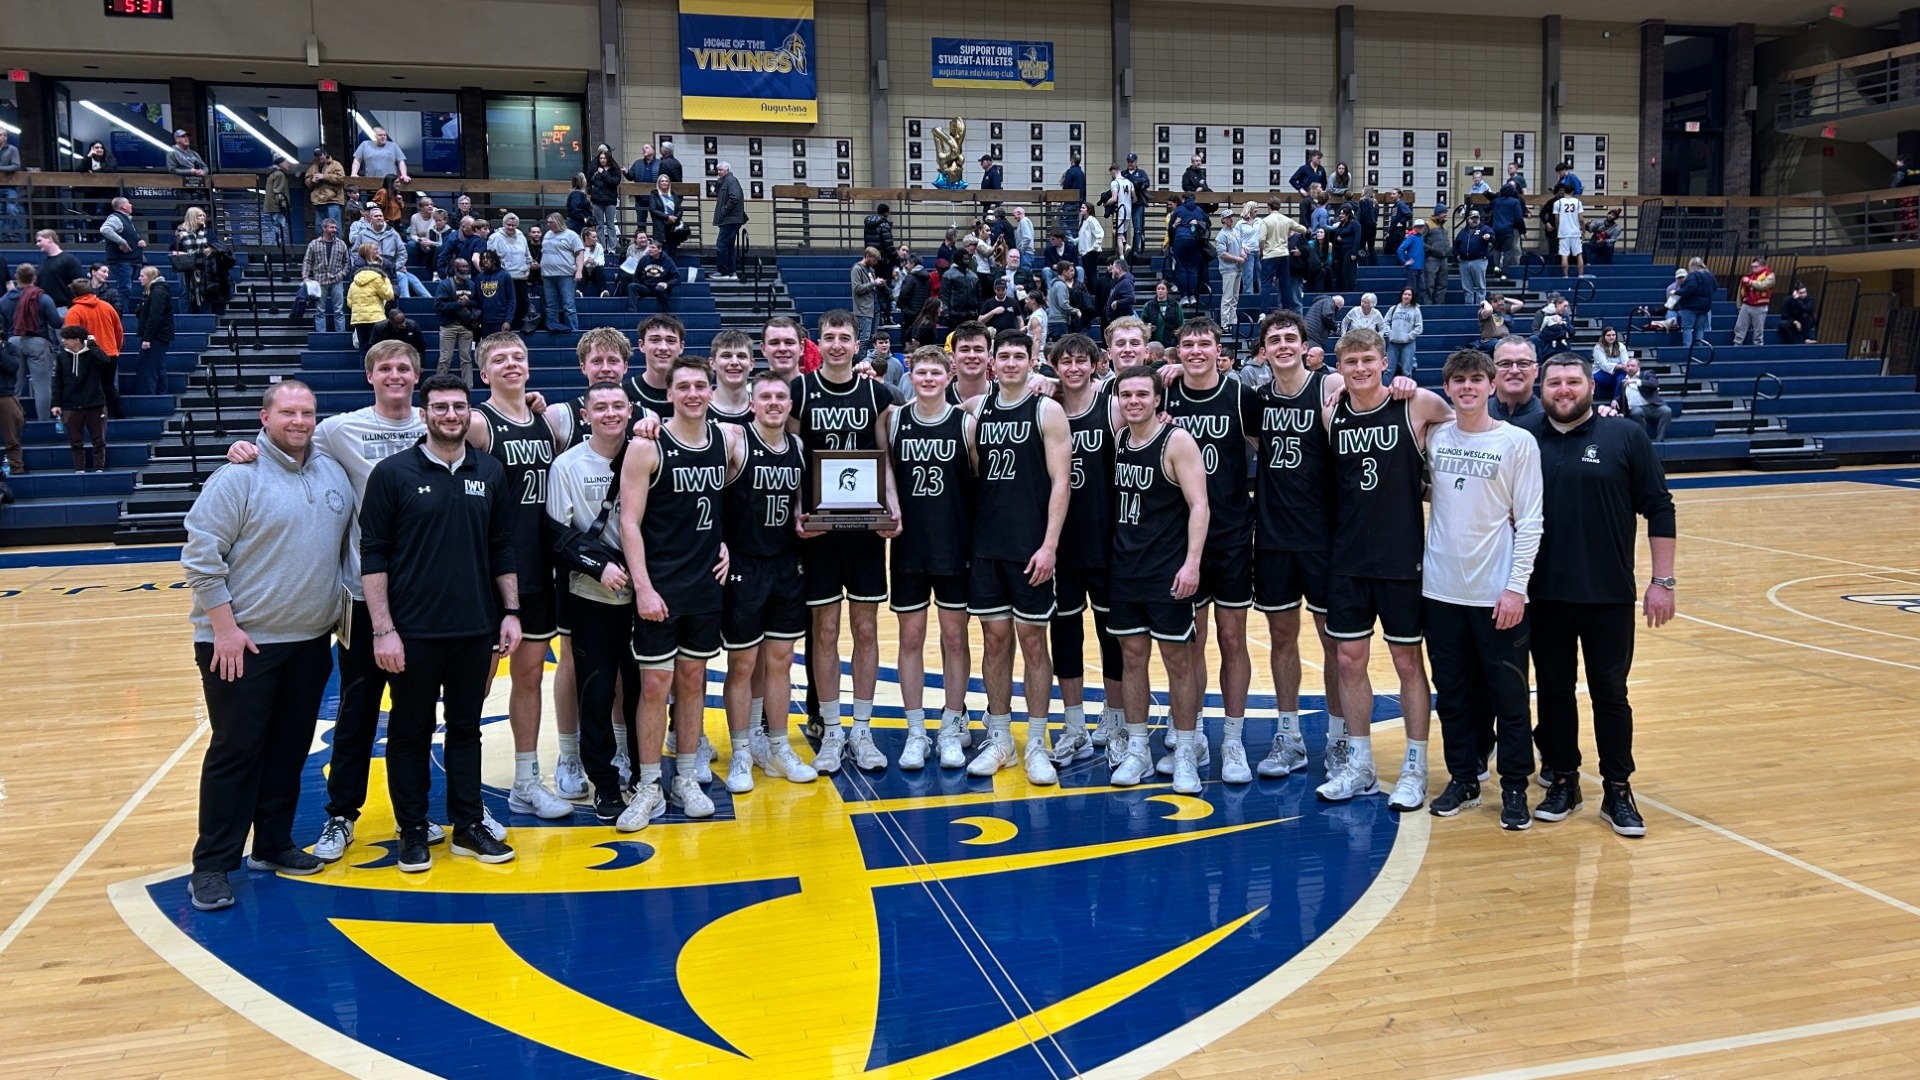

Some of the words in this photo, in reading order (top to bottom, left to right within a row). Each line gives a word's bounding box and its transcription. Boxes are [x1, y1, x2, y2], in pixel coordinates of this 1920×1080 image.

[125, 0, 163, 13] 5:31
[703, 38, 731, 48] HOME
[732, 40, 745, 49] OF
[746, 40, 765, 49] THE
[960, 45, 995, 55] SUPPORT
[997, 46, 1013, 56] OUR
[688, 47, 793, 74] VIKINGS
[938, 54, 1013, 67] STUDENT-ATHLETES
[938, 68, 1014, 78] augustana.edu/viking-club
[1021, 69, 1046, 79] CLUB
[761, 103, 807, 114] Augustana
[1564, 203, 1575, 213] 23
[811, 406, 868, 430] IWU
[1262, 406, 1315, 433] IWU
[362, 432, 397, 441] ILLINOIS
[980, 421, 1032, 445] IWU
[1338, 424, 1399, 454] IWU
[503, 439, 553, 465] IWU
[901, 437, 957, 462] IWU
[1269, 436, 1302, 469] 25
[1463, 449, 1502, 462] WESLEYAN
[1581, 456, 1600, 464] TITANS
[987, 448, 1016, 480] 22
[1115, 463, 1154, 490] IWU
[1360, 457, 1378, 491] 3
[1440, 456, 1493, 478] TITANS
[464, 479, 486, 492] IWU
[520, 469, 546, 504] 21
[672, 466, 725, 492] IWU
[753, 466, 801, 491] IWU
[912, 466, 944, 496] 23
[696, 496, 713, 531] 2
[764, 495, 790, 527] 15
[1119, 491, 1141, 525] 14
